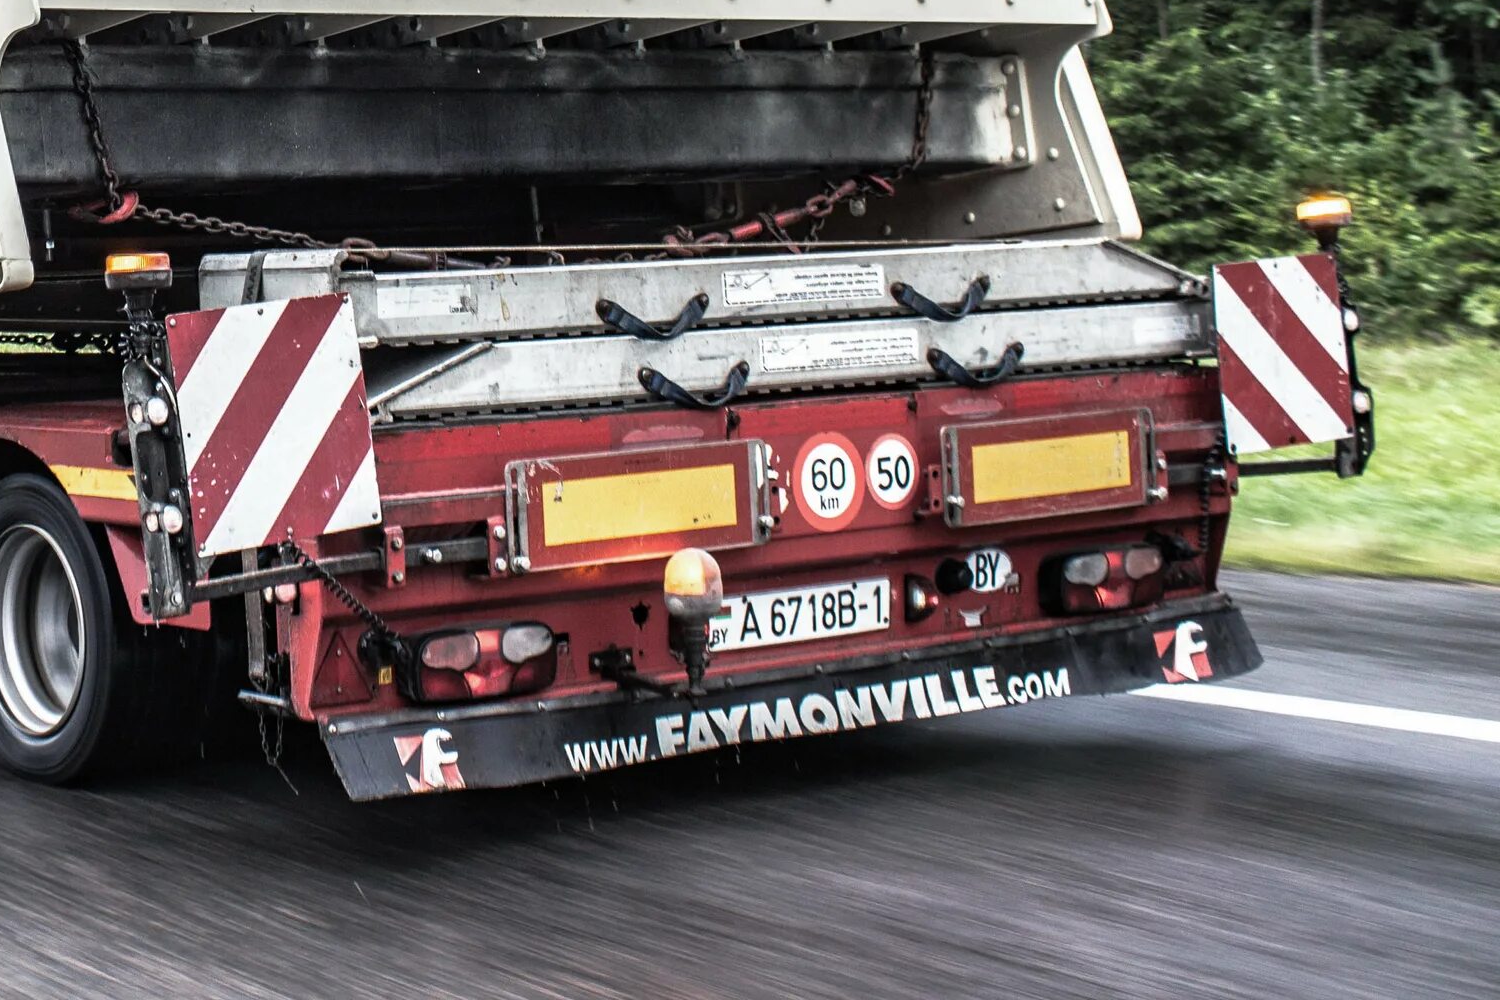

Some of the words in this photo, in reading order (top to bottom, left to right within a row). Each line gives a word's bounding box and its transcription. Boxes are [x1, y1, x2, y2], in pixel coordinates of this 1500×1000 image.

[812, 457, 846, 492] 60
[877, 455, 910, 491] 50
[820, 495, 839, 510] km
[975, 551, 1000, 588] BY
[712, 628, 728, 644] BY
